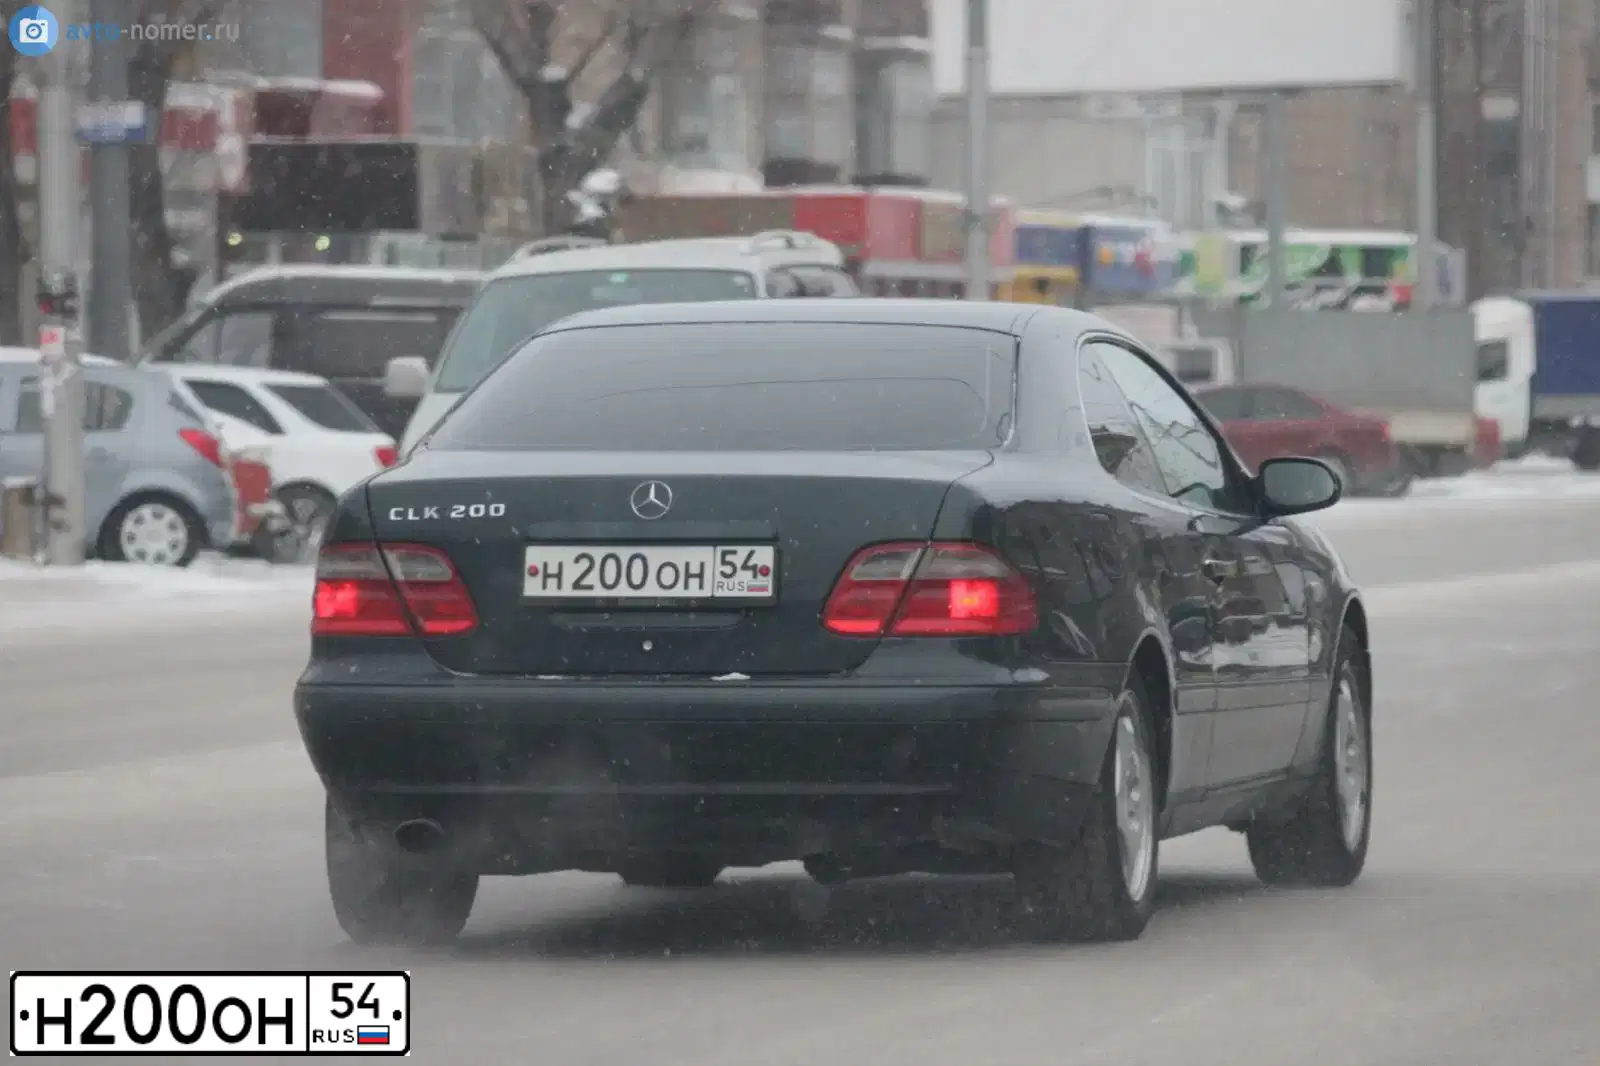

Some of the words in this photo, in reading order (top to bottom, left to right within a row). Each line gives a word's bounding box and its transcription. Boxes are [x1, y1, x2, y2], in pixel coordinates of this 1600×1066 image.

[389, 506, 440, 521] CLK
[450, 503, 506, 519] 200
[719, 549, 759, 579] 54
[716, 581, 745, 593] RUS
